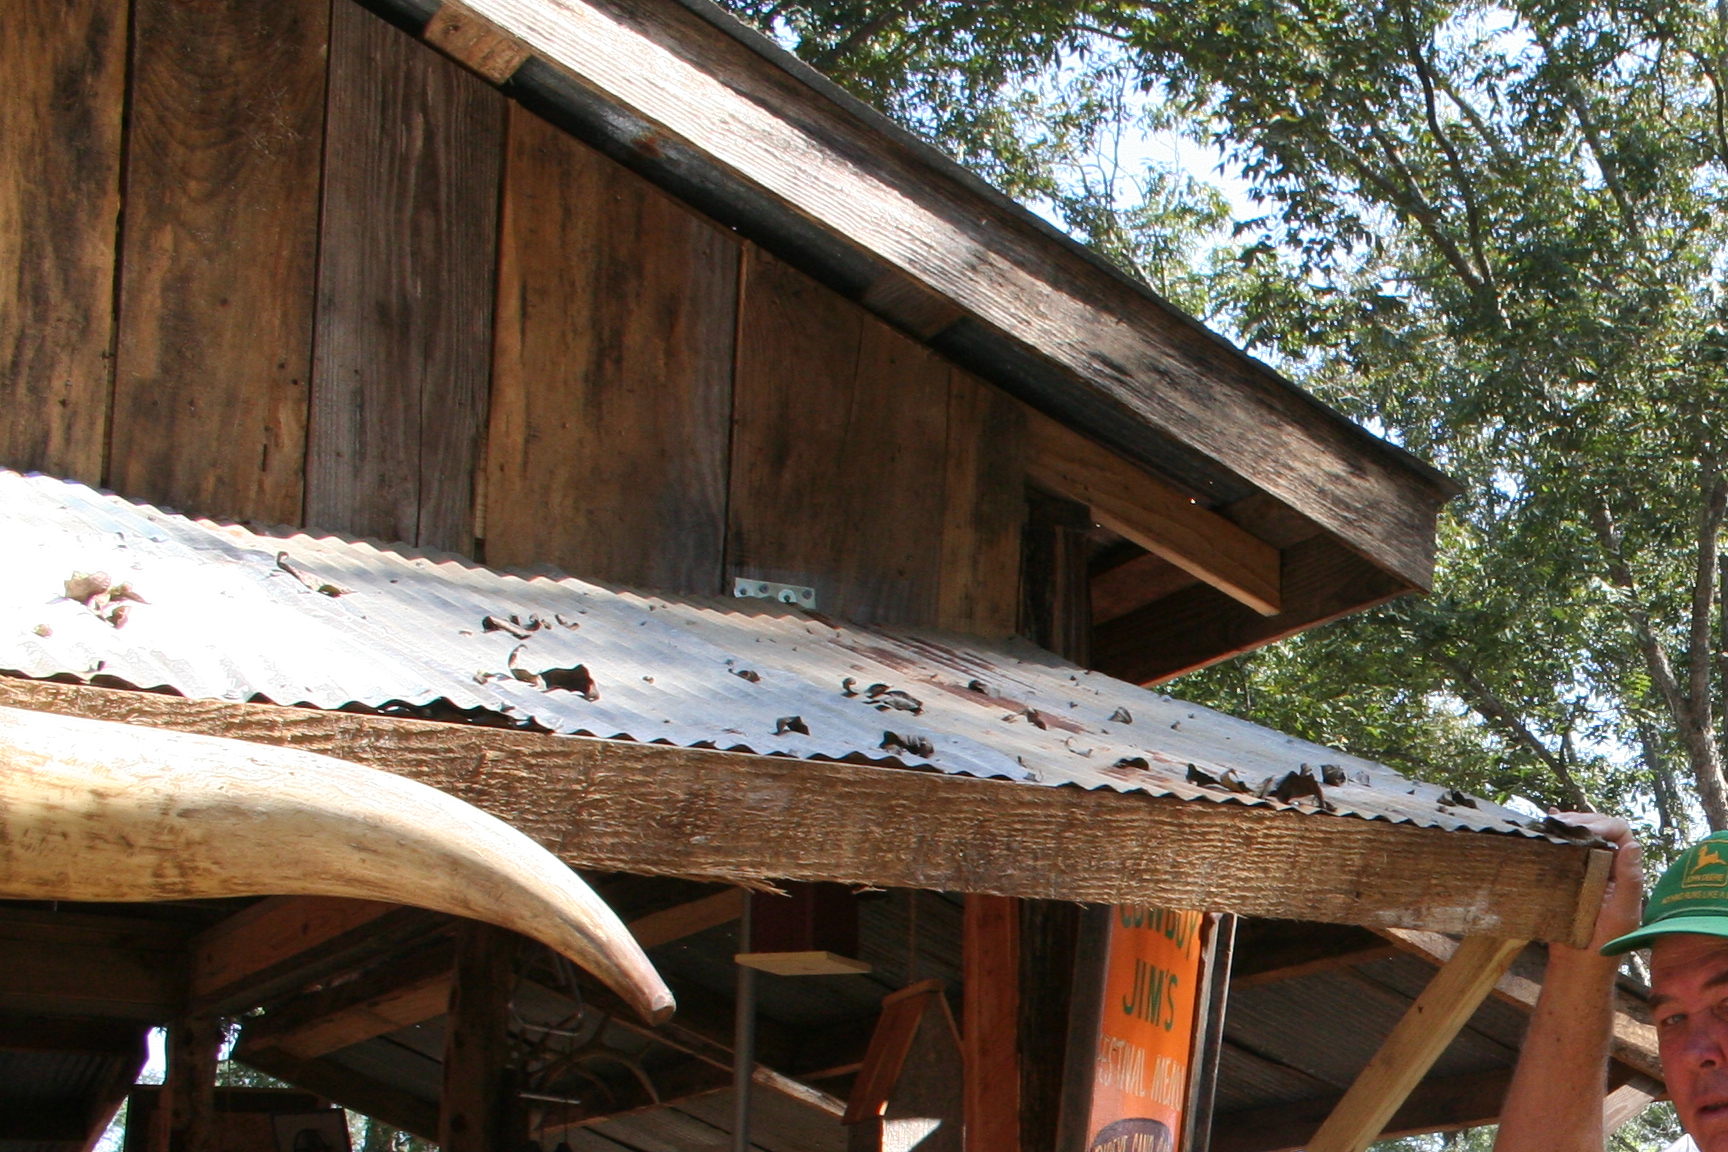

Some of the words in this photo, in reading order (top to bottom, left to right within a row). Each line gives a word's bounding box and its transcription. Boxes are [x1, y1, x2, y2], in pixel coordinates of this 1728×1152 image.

[1122, 957, 1178, 1032] JIM'S
[1097, 1035, 1147, 1098] ESTIVAL
[1150, 1053, 1187, 1113] MENU
